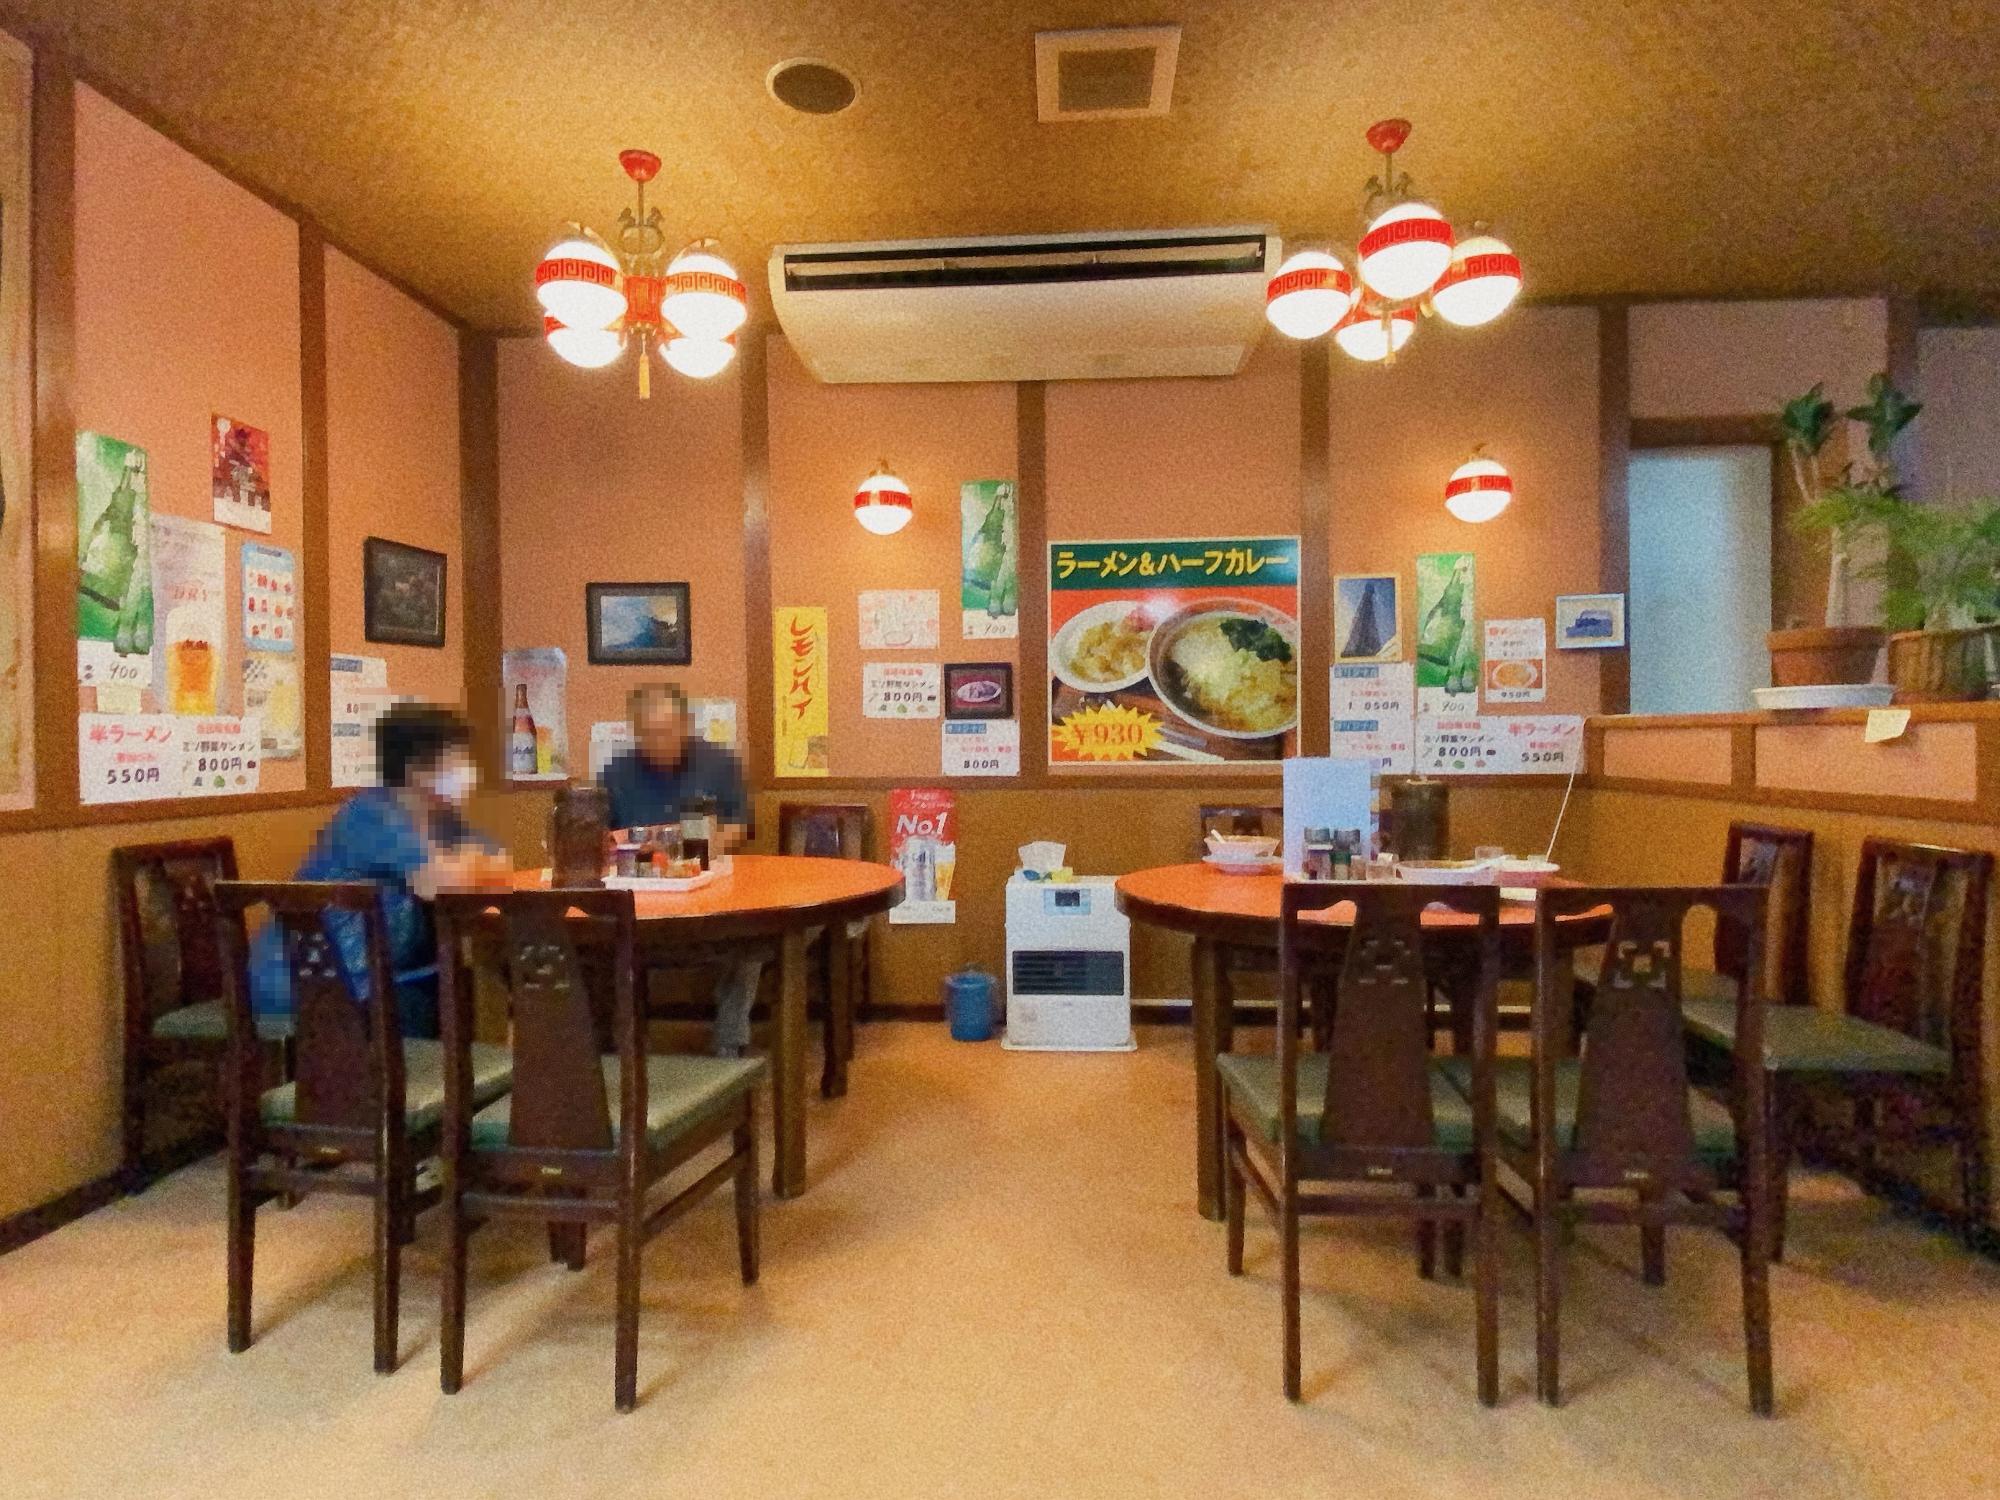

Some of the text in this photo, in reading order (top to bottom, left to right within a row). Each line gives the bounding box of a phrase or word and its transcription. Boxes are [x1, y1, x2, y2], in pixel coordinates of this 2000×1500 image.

[1056, 547, 1290, 579] ラーメン&ハーフカレー
[789, 616, 815, 720] レモンハイ
[1072, 722, 1144, 745] ¥930
[1438, 746, 1482, 757] 800円
[1520, 751, 1565, 763] 550円
[197, 756, 242, 772] 800円
[107, 766, 160, 785] 550円
